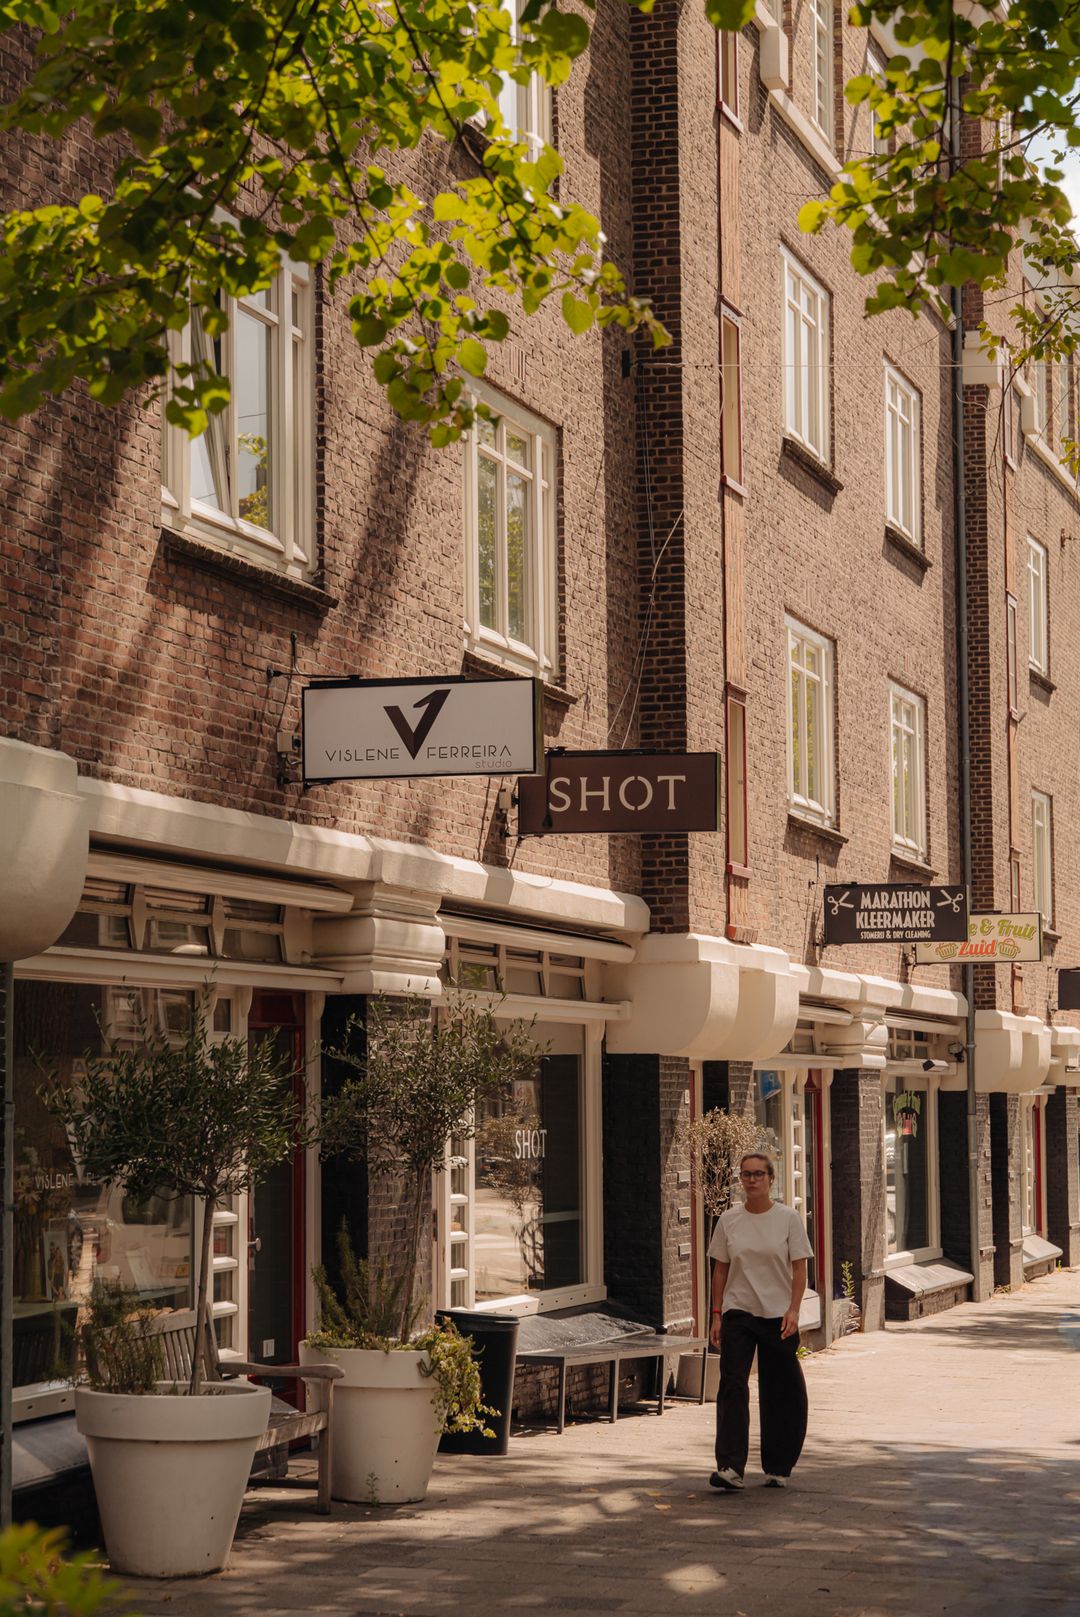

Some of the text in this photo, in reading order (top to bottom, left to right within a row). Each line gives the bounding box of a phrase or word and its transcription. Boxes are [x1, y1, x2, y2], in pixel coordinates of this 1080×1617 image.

[325, 744, 513, 762] VISLENE FERREIRA
[475, 758, 512, 769] studio
[548, 774, 687, 813] SHOT
[860, 890, 931, 910] MARATHON
[855, 910, 936, 929] KLEERMAKER
[892, 930, 904, 939] DRY
[904, 930, 932, 939] CLEANING
[997, 919, 1037, 941] Fruit
[958, 939, 998, 957] Zuid
[514, 1129, 548, 1160] SHOT
[35, 1172, 74, 1189] VISLENE
